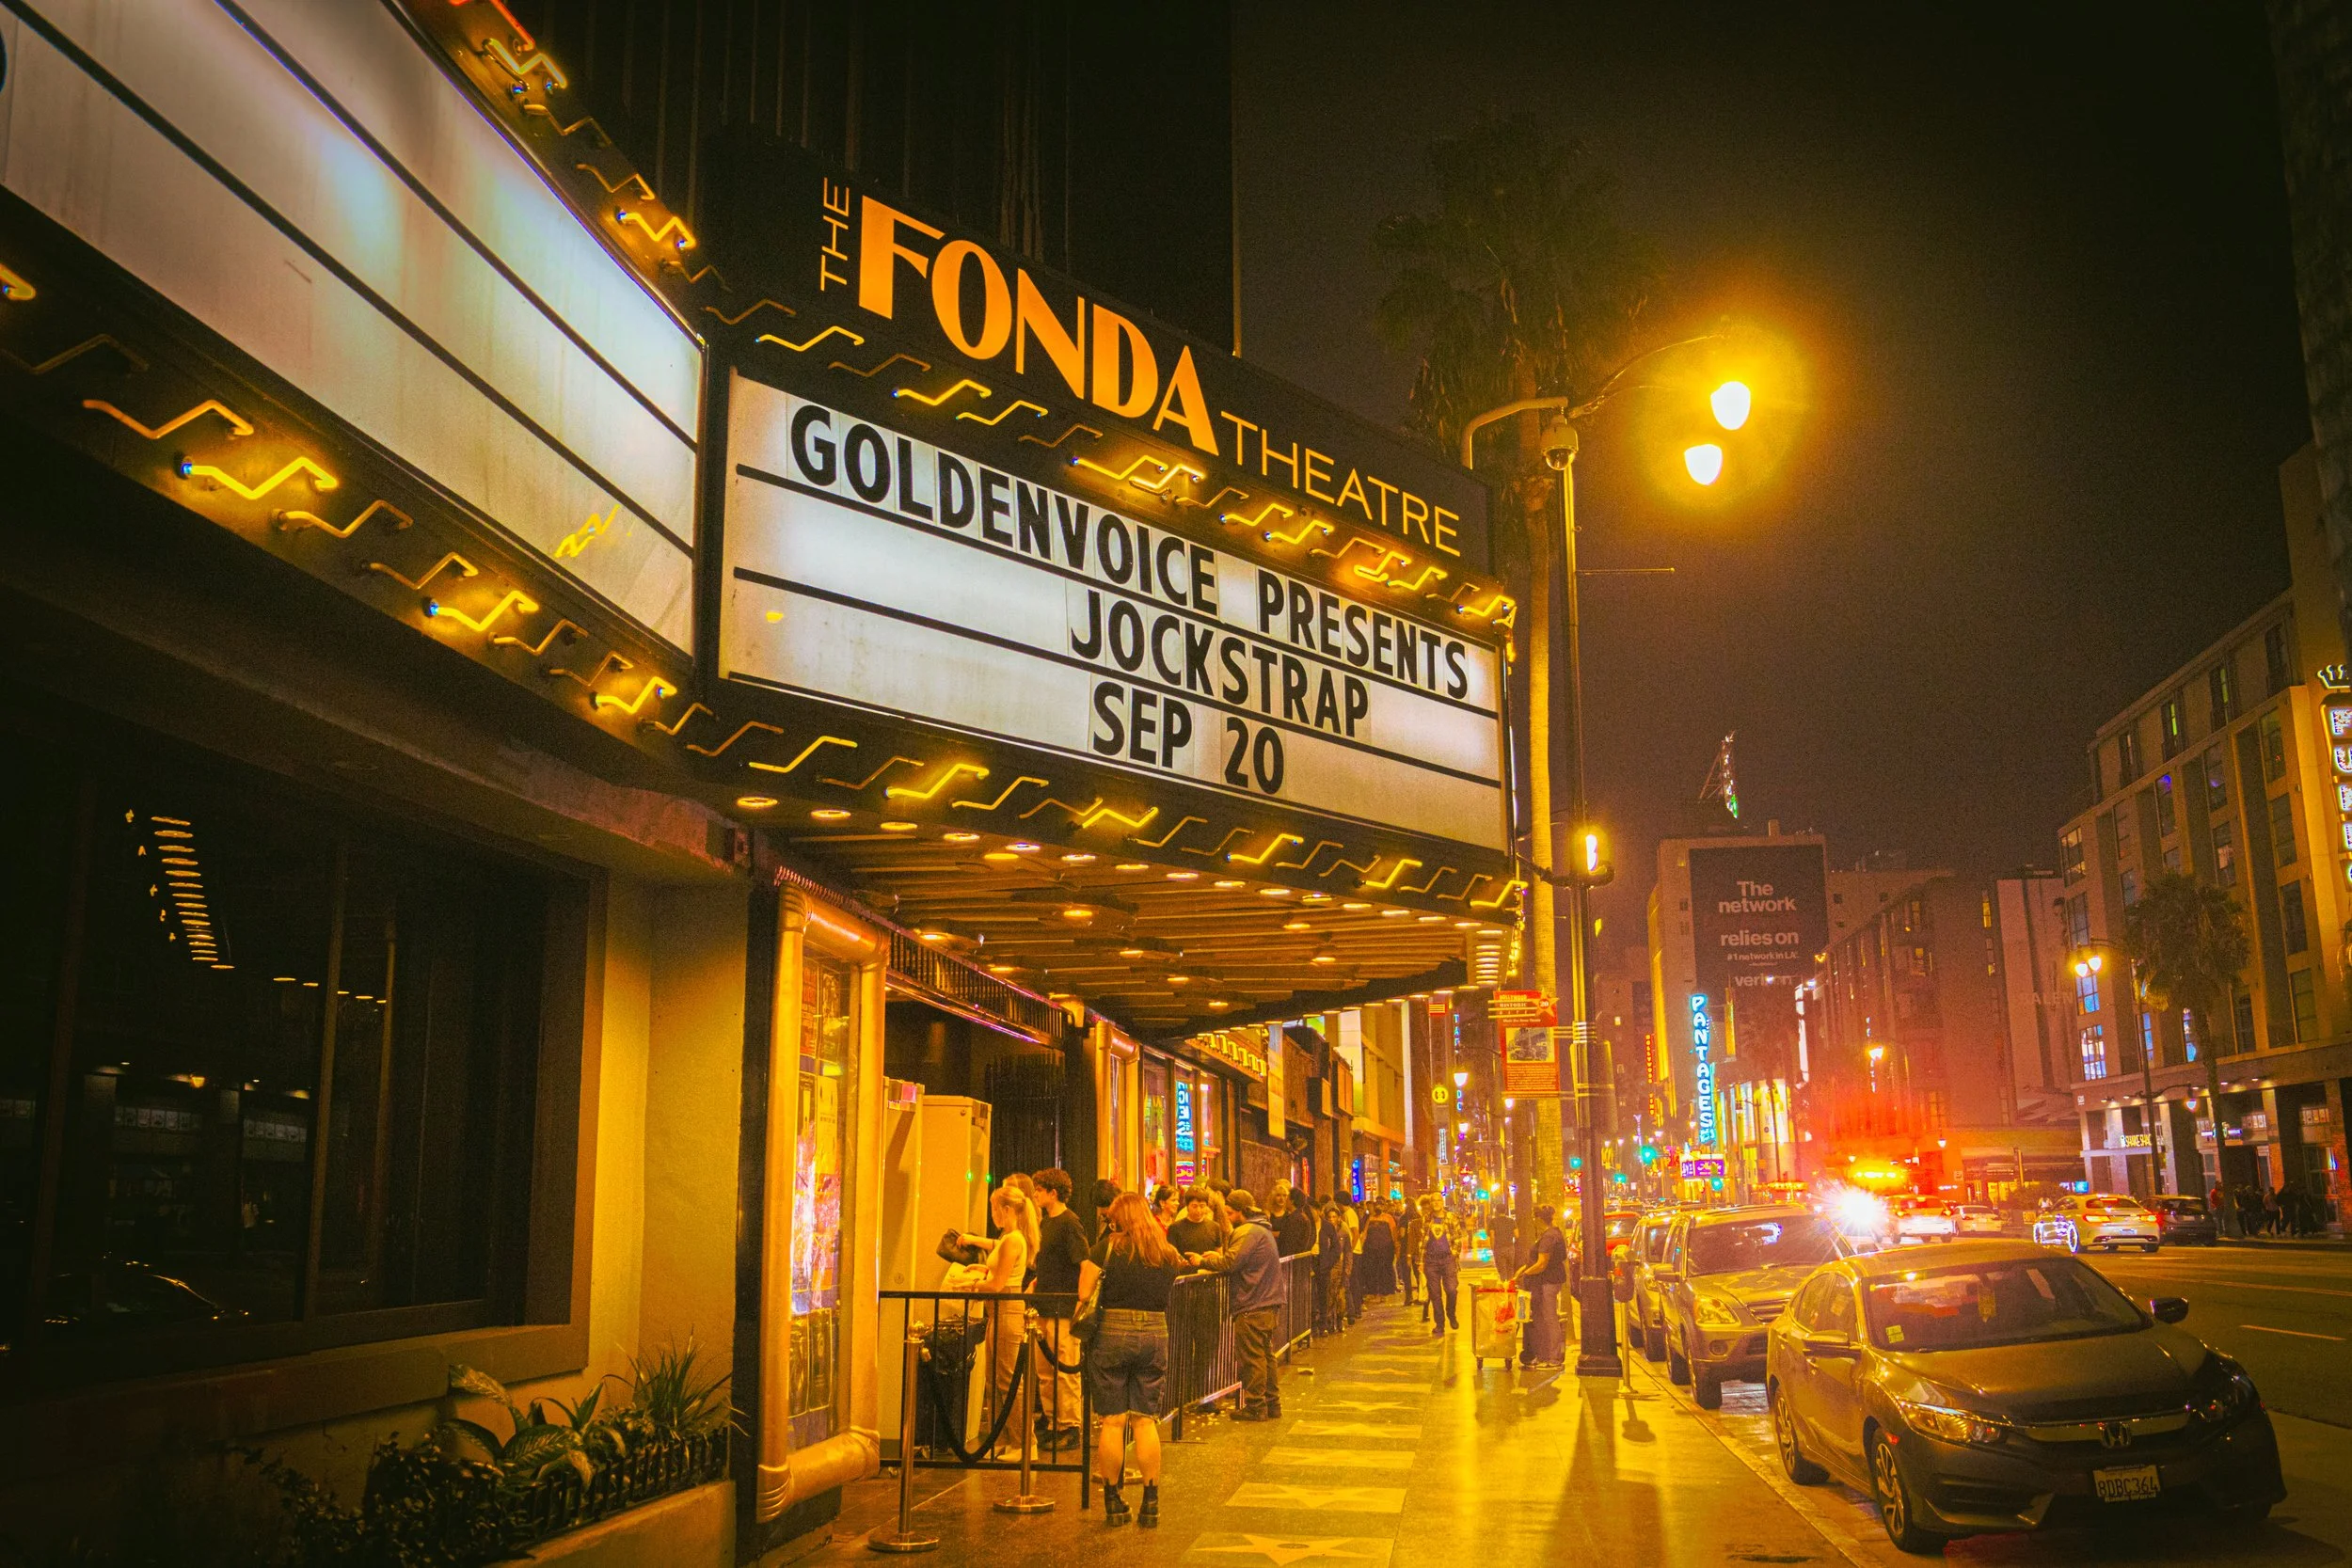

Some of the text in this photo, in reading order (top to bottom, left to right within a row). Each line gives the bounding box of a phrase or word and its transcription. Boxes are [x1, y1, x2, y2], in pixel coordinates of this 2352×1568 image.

[820, 177, 850, 292] THE
[858, 195, 1461, 558] FONDA THEATRE
[790, 404, 1470, 701] GOLDENVOICE PRESENTS
[1071, 591, 1369, 739] JOCKSTRAP
[1092, 682, 1284, 795] SEP 20
[1718, 896, 1797, 913] network
[1720, 929, 1799, 946] relies on
[1737, 880, 1774, 896] The
[1739, 951, 1776, 961] network
[1691, 994, 1714, 1127] PANTAGES
[2098, 1476, 2158, 1497] 8DBC364
